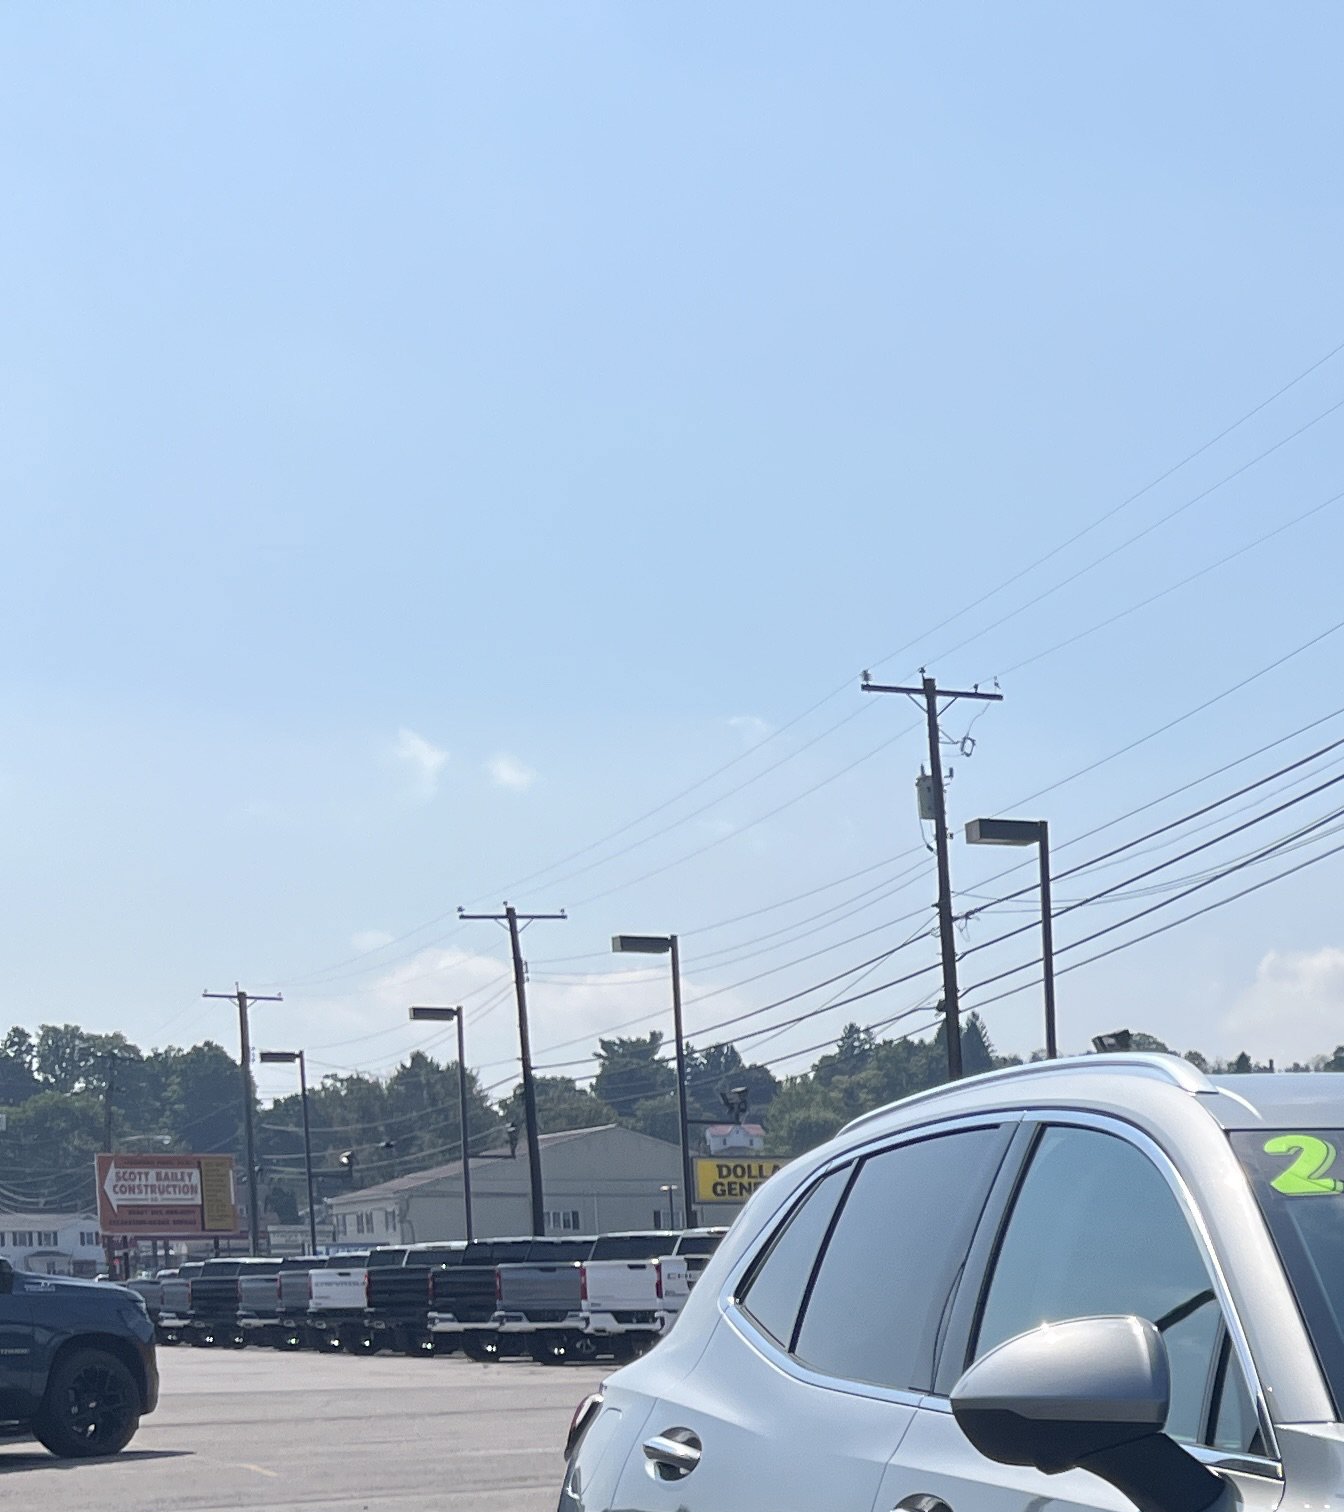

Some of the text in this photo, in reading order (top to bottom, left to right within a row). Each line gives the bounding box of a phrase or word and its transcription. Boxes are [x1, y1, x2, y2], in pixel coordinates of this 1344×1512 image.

[115, 1171, 193, 1183] SCOTT BAILEY
[716, 1164, 781, 1179] DOLLA
[113, 1184, 198, 1195] CONSTRUCTION
